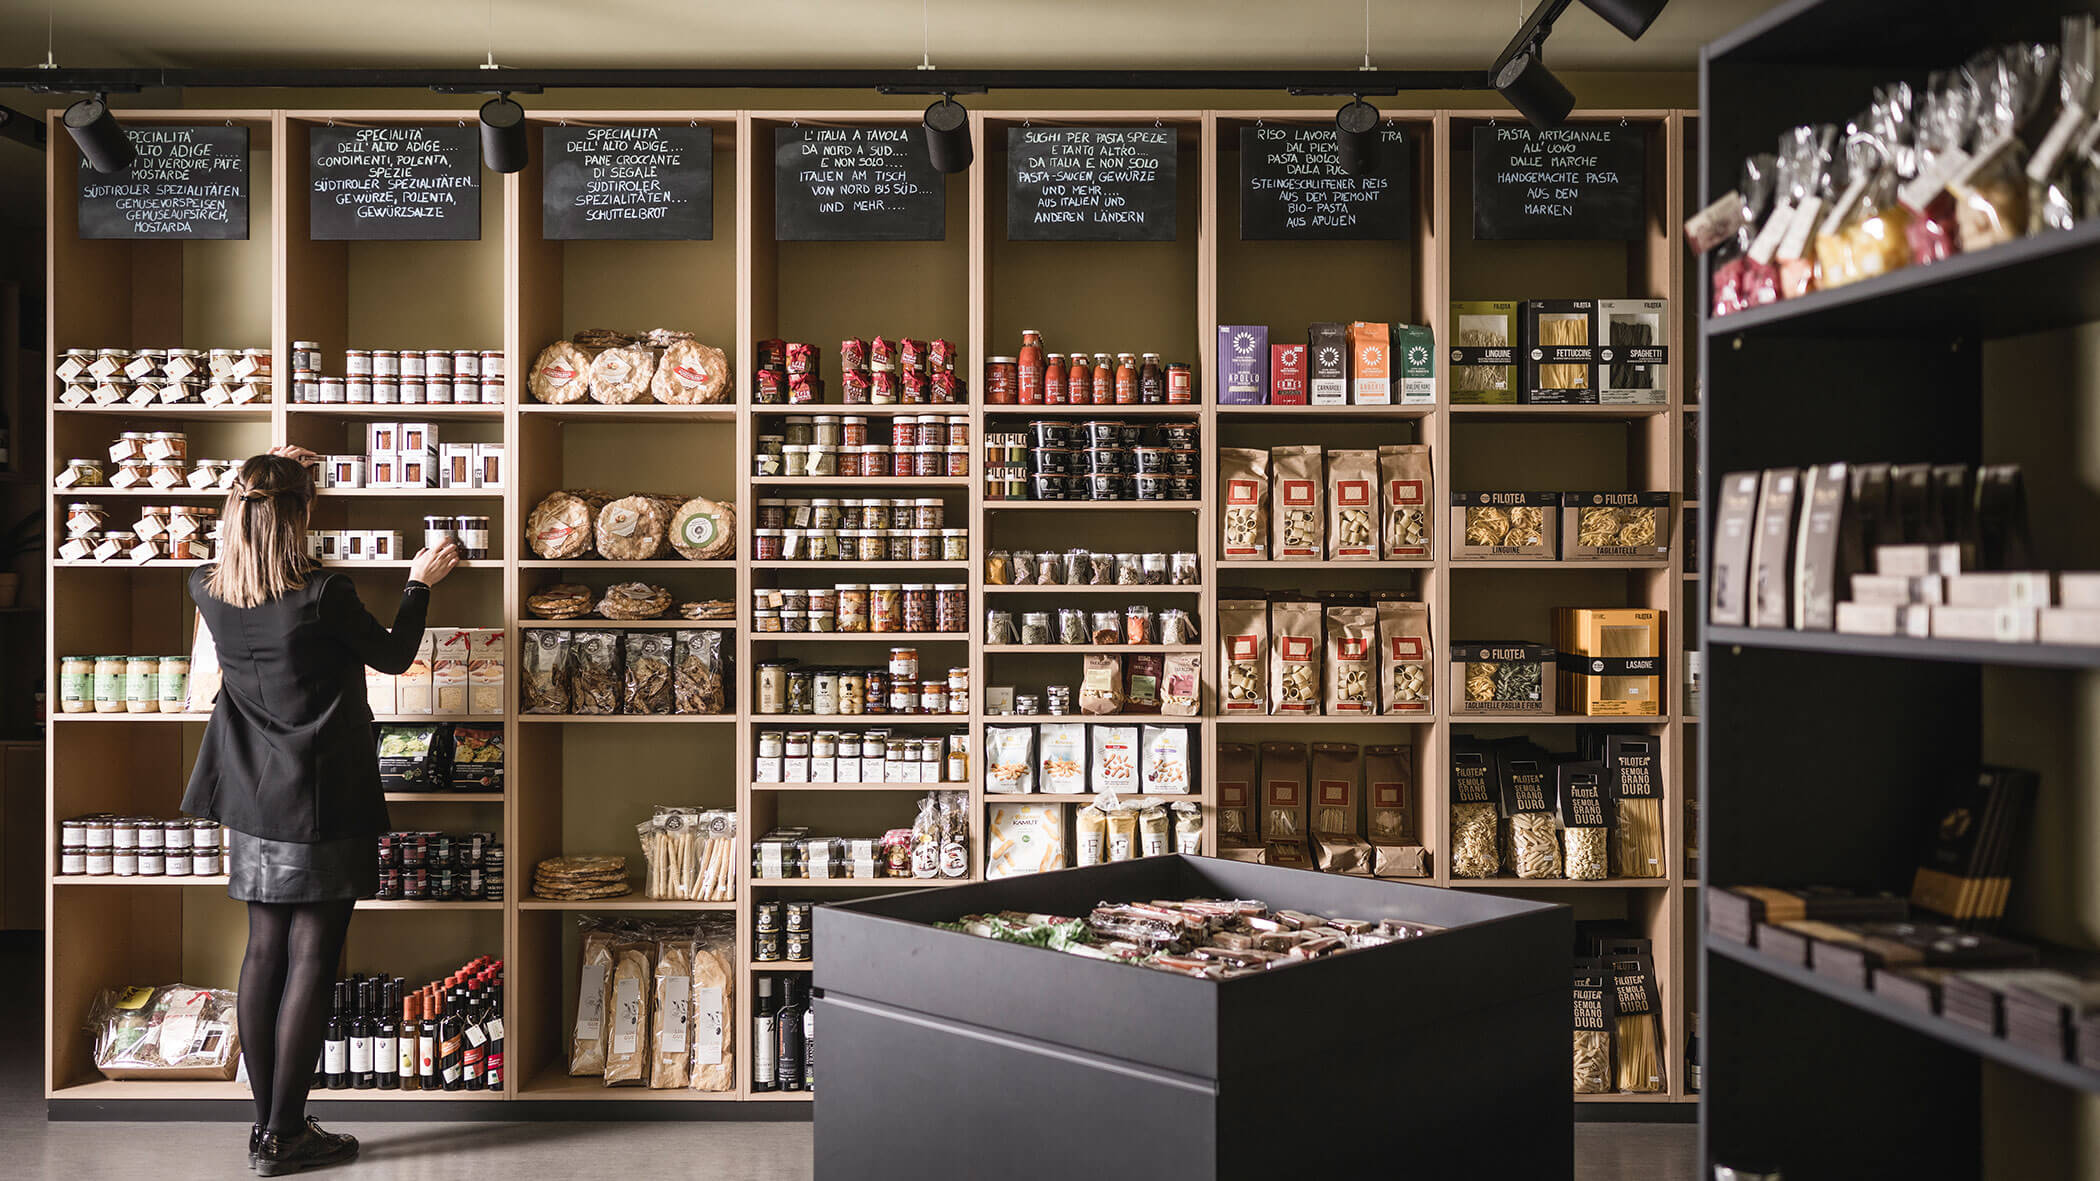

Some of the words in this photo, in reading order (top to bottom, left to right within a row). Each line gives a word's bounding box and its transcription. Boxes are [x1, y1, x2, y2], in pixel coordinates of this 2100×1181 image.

[852, 130, 862, 141] A
[866, 130, 909, 142] TAVOLA
[1024, 132, 1061, 144] SUGHI
[1068, 132, 1090, 144] PER
[1127, 132, 1168, 144] SPEZIE
[1258, 129, 1286, 140] RISO
[1294, 130, 1337, 141] LAVORA
[1497, 128, 1531, 142] PASTA
[1538, 130, 1611, 142] ARTIGIANALE
[371, 141, 398, 152] ALTO
[566, 142, 598, 152] DELL'
[602, 140, 628, 152] ALTO
[802, 144, 818, 156] DA
[823, 145, 852, 156] NORD
[856, 145, 864, 155] A
[1052, 145, 1058, 155] E
[1062, 144, 1094, 156] TANTO
[1286, 142, 1305, 153] DAL
[1310, 142, 1339, 152] PIEM
[1547, 144, 1576, 154] UOVO
[144, 159, 154, 169] DI
[317, 155, 393, 168] CONDIMENTI,
[396, 154, 452, 168] POLENTA,
[584, 155, 612, 166] PANE
[616, 154, 680, 166] CROCCANTE
[820, 158, 830, 168] E
[834, 158, 856, 168] NON
[1028, 158, 1046, 168] DA
[1050, 158, 1080, 168] ITALIA
[1086, 158, 1096, 168] E
[1100, 158, 1124, 168] NON
[1128, 158, 1158, 169] SOLO
[1268, 154, 1298, 164] PASTA
[1510, 156, 1543, 167] DALLE
[1551, 156, 1598, 168] MARCHE
[132, 170, 190, 181] MOSTARDE
[368, 168, 412, 178] SPEZIE
[594, 168, 605, 178] DI
[610, 166, 657, 178] SEGALE
[1286, 165, 1320, 175] DALLA
[1326, 165, 1350, 175] PUG
[800, 170, 844, 182] ITALIEN
[852, 170, 867, 182] AM
[874, 170, 906, 182] TISCH
[1497, 172, 1580, 184] HANDGEMACHTE
[1586, 172, 1619, 184] PASTA
[314, 177, 380, 192] SÜDTIROLER
[1362, 178, 1388, 189] REIS
[84, 184, 150, 198] SÜDTIROLER
[812, 186, 835, 196] VON
[840, 184, 870, 195] NORD
[874, 184, 890, 194] BIS
[1042, 186, 1066, 196] UND
[1526, 187, 1550, 200] AUS
[1555, 188, 1578, 200] DEN
[336, 190, 398, 206] GEWÜRZE,
[402, 192, 457, 206] POLENTA,
[1279, 190, 1299, 202] AUS
[1306, 192, 1328, 202] DEM
[1334, 190, 1380, 202] PIEMONT
[820, 201, 844, 212] UND
[1038, 198, 1056, 208] AUS
[1060, 196, 1099, 207] ITALIEN
[1104, 196, 1126, 207] UND
[356, 204, 445, 218] GEWÜRZSALZE
[1316, 202, 1349, 214] PASTA
[1524, 204, 1573, 216] MARKEN
[1034, 212, 1084, 223] ANDEREN
[1094, 209, 1144, 223] LÄNDERN
[1286, 216, 1306, 228] AUS
[1312, 214, 1356, 227] APULIEN
[134, 221, 192, 233] MOSTARDA
[1630, 349, 1662, 358] SPAGHETTI
[1228, 374, 1260, 382] APOLLO
[1492, 493, 1526, 504] FILOTEA
[1605, 494, 1639, 505] FILOTEA
[1492, 648, 1526, 660] FILOTEA
[1626, 660, 1653, 670] LASAGNE
[1620, 757, 1648, 767] FILOTEA
[1620, 768, 1649, 776] SEMOLA
[1458, 778, 1484, 786] SEMOLA
[1622, 775, 1650, 784] GRANO
[1458, 785, 1486, 793] GRANO
[1515, 784, 1541, 792] SEMOLA
[1571, 788, 1598, 798] FILOTEA
[1622, 784, 1650, 795] DURO
[1460, 792, 1488, 800] DURO
[1516, 792, 1543, 800] GRANO
[1518, 800, 1545, 810] DURO
[1574, 806, 1600, 814] GRANO
[1574, 814, 1602, 824] DURO
[1615, 976, 1642, 986] FILOTEA
[1573, 990, 1602, 1000] FILOTEA
[1616, 985, 1644, 994] SEMOLA
[1618, 992, 1646, 1002] GRANO
[1573, 1000, 1602, 1010] SEMOLA
[1620, 1000, 1648, 1012] DURO
[1574, 1008, 1602, 1017] GRANO
[1574, 1017, 1604, 1028] DURO
